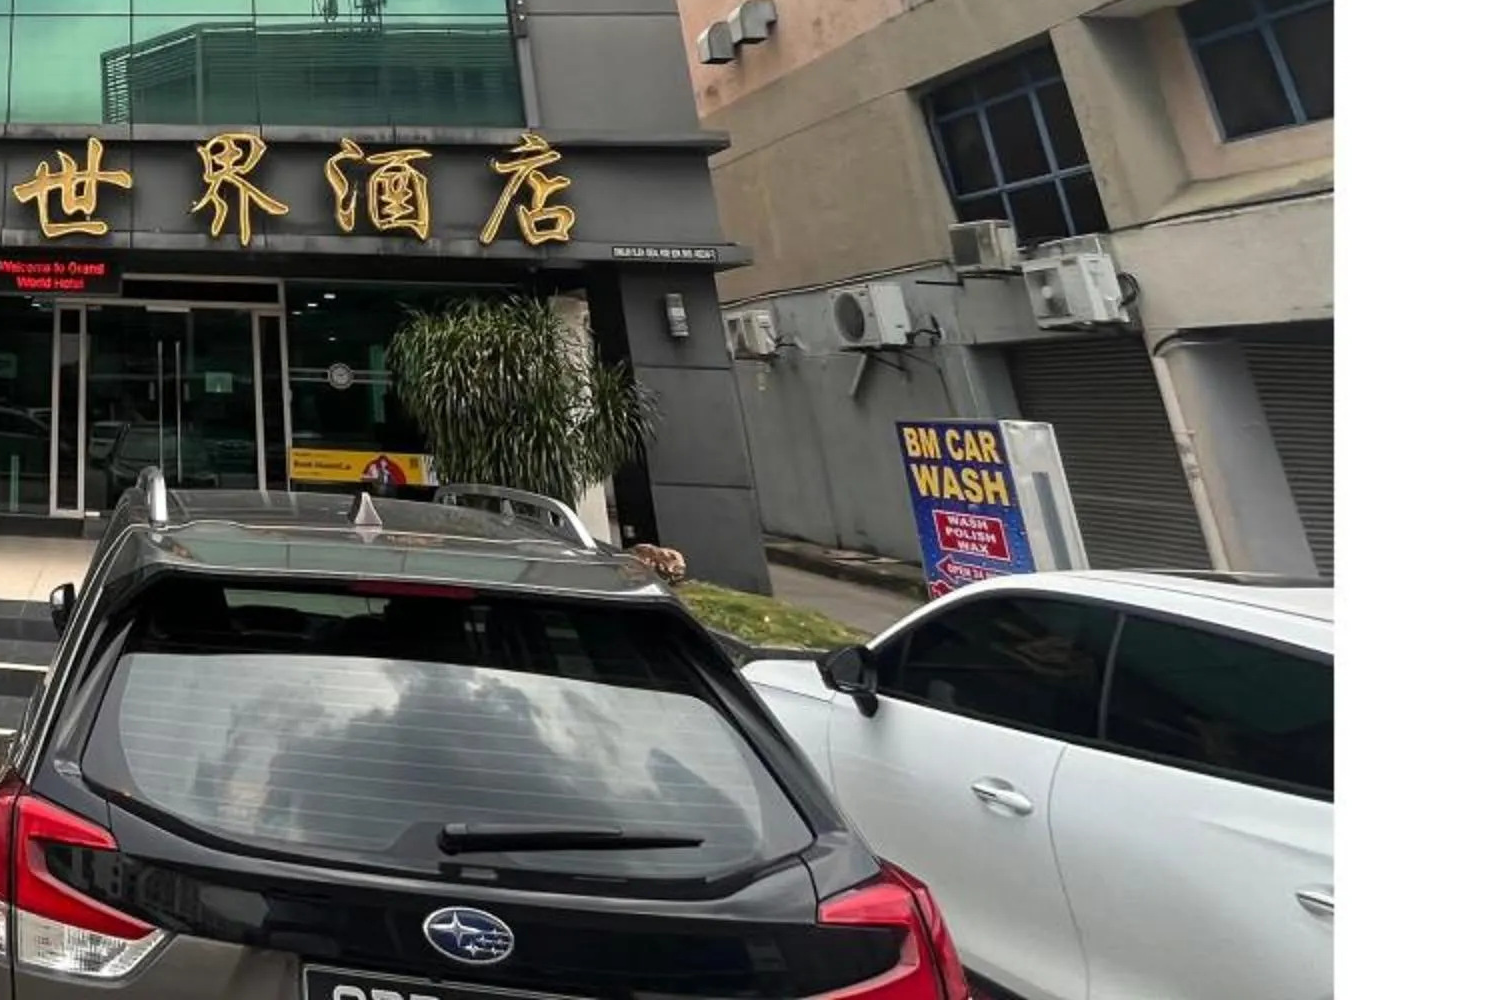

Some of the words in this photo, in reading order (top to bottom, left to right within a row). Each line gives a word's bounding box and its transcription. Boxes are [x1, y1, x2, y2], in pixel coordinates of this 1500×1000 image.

[54, 261, 65, 273] to
[67, 261, 105, 275] Grand
[16, 276, 52, 289] World
[903, 427, 942, 459] BM
[945, 429, 1003, 464] CAR
[909, 463, 1011, 506] WASH
[947, 515, 989, 530] WASH
[945, 526, 997, 543] POLISH
[957, 540, 988, 553] WAX
